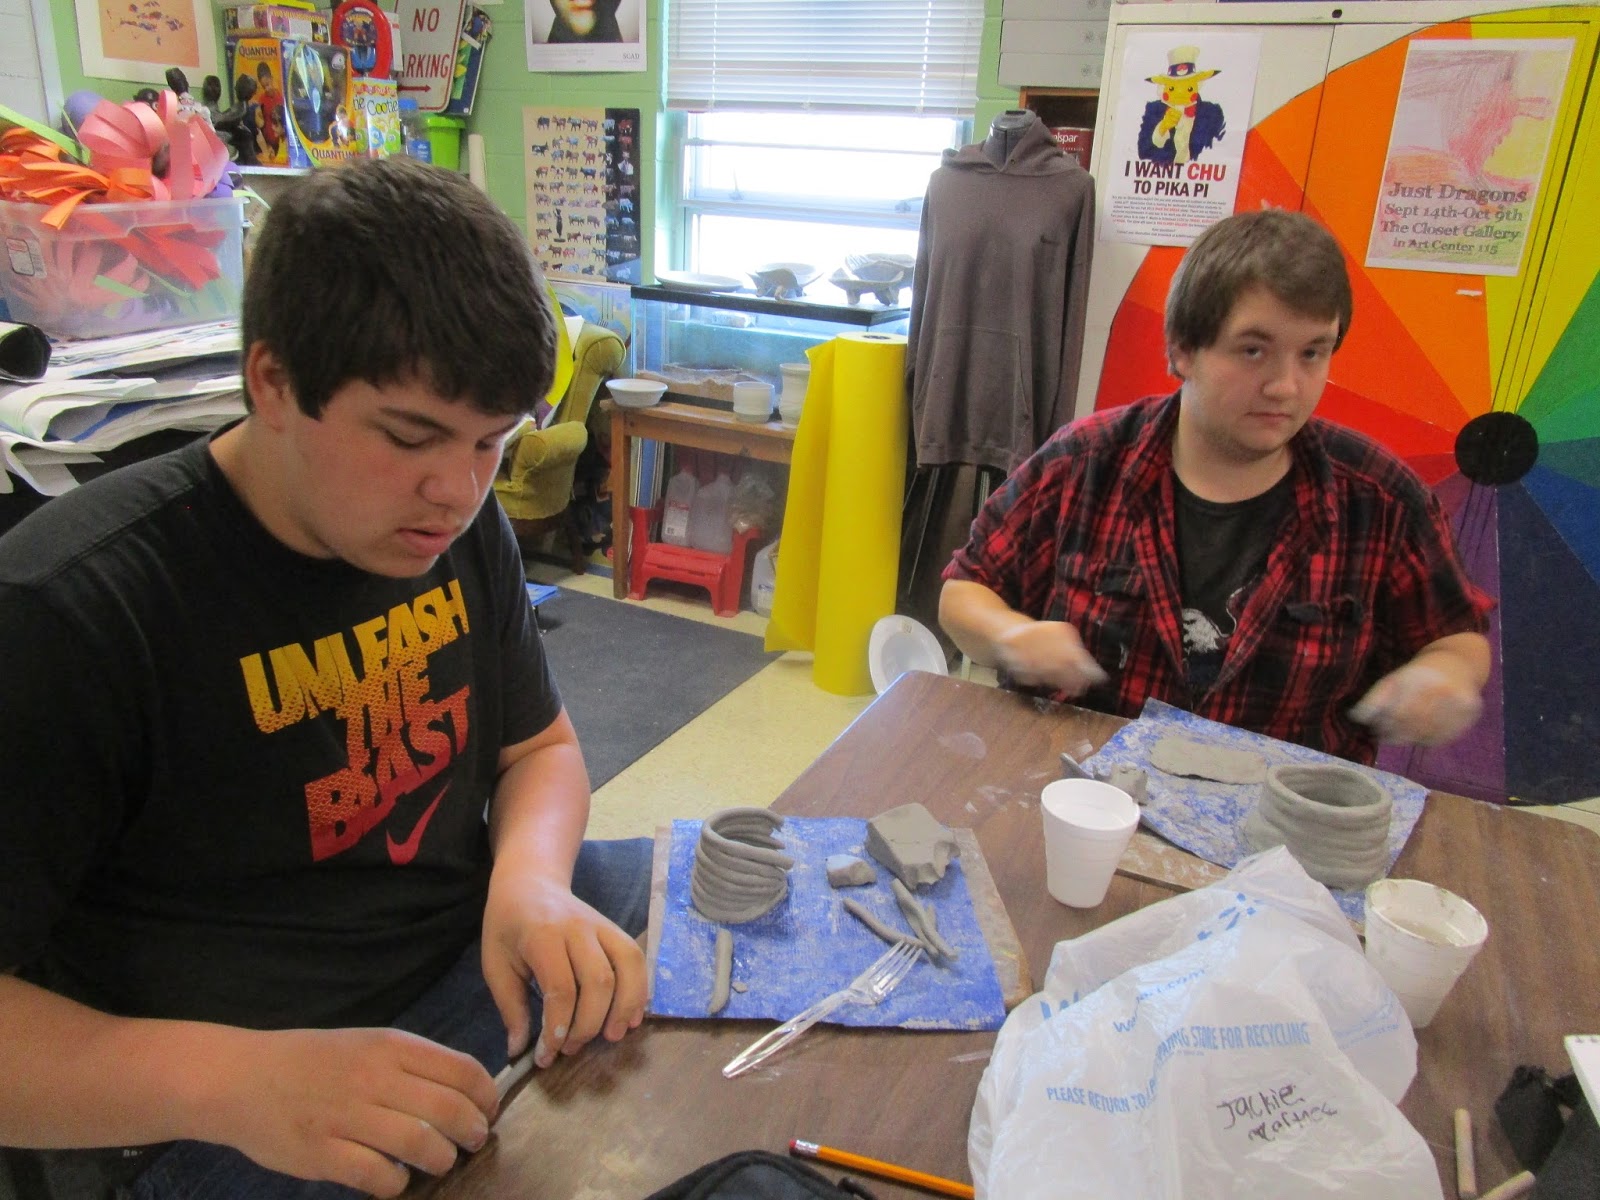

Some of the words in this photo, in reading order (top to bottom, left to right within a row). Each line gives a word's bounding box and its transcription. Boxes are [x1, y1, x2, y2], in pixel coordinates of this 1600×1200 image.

[411, 8, 440, 32] NO
[239, 45, 278, 57] QUANTUM
[1124, 160, 1131, 177] I
[1135, 161, 1184, 179] WANT
[1187, 162, 1227, 182] CHU
[1133, 179, 1151, 195] TO
[1154, 180, 1190, 197] PIKA
[1193, 182, 1209, 198] PI
[1387, 182, 1433, 199] Just
[1437, 183, 1528, 205] Dragons
[1384, 203, 1419, 218] Sept
[1423, 204, 1491, 221] 14th-Oct
[1494, 207, 1523, 223] 9th
[1380, 220, 1409, 234] The
[1412, 222, 1459, 236] Closet
[1463, 225, 1520, 242] Gallery
[1392, 237, 1406, 248] in
[1408, 238, 1429, 249] Art
[1431, 240, 1475, 252] Center
[1478, 244, 1498, 255] 115
[239, 578, 471, 734] UNLEASH
[1045, 1085, 1086, 1106] PLEASE
[1087, 1089, 1131, 1114] RETURN
[1220, 1026, 1244, 1049] FOR
[1246, 1021, 1312, 1048] RECYCLING
